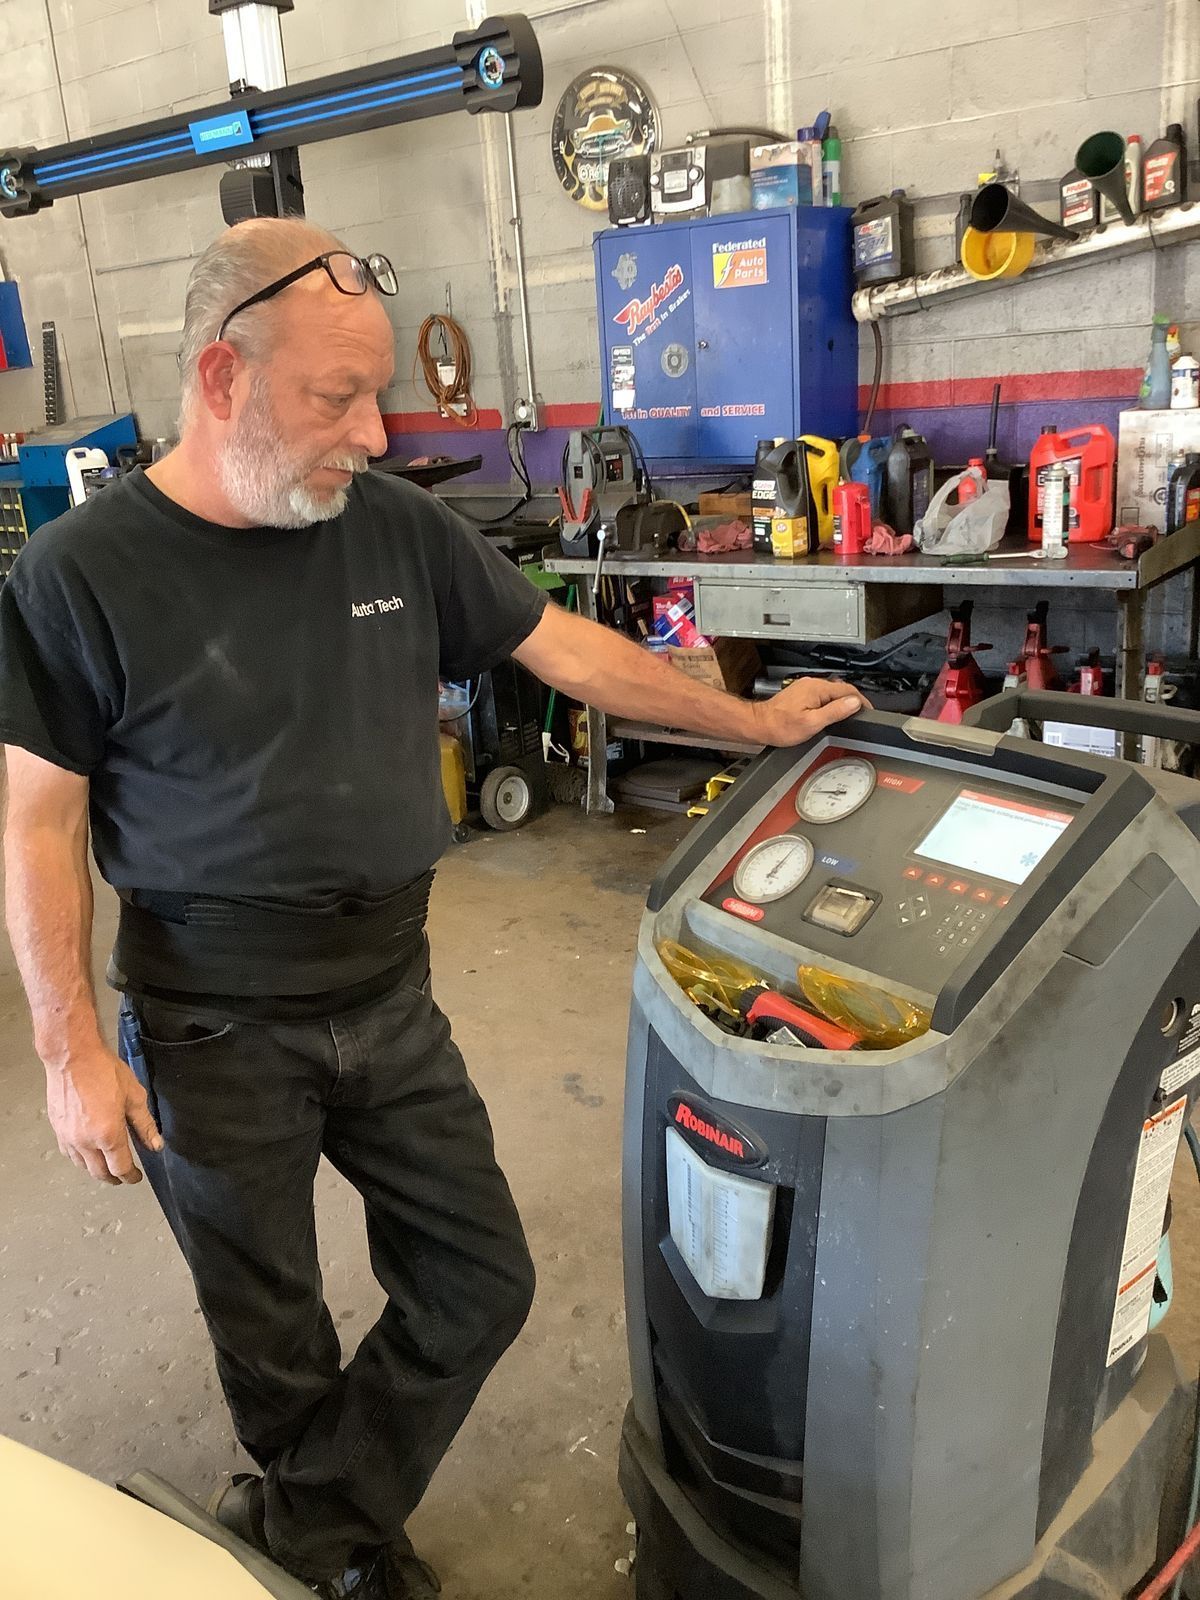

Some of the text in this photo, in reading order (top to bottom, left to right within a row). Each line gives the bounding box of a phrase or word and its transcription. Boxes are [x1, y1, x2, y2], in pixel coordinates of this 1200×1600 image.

[712, 237, 766, 253] Federated
[739, 256, 764, 268] Auto
[734, 268, 764, 279] Parts
[613, 263, 684, 336] Raybestos
[632, 333, 647, 347] The
[668, 288, 691, 313] Brakes
[649, 405, 692, 419] QUALITY
[701, 406, 720, 417] and
[722, 404, 765, 417] SERVICE
[752, 490, 777, 500] EDGE
[351, 596, 404, 618] Auto Tech
[883, 776, 903, 787] HIGH
[821, 856, 840, 866] LOW
[675, 1102, 744, 1158] ROBINAIR
